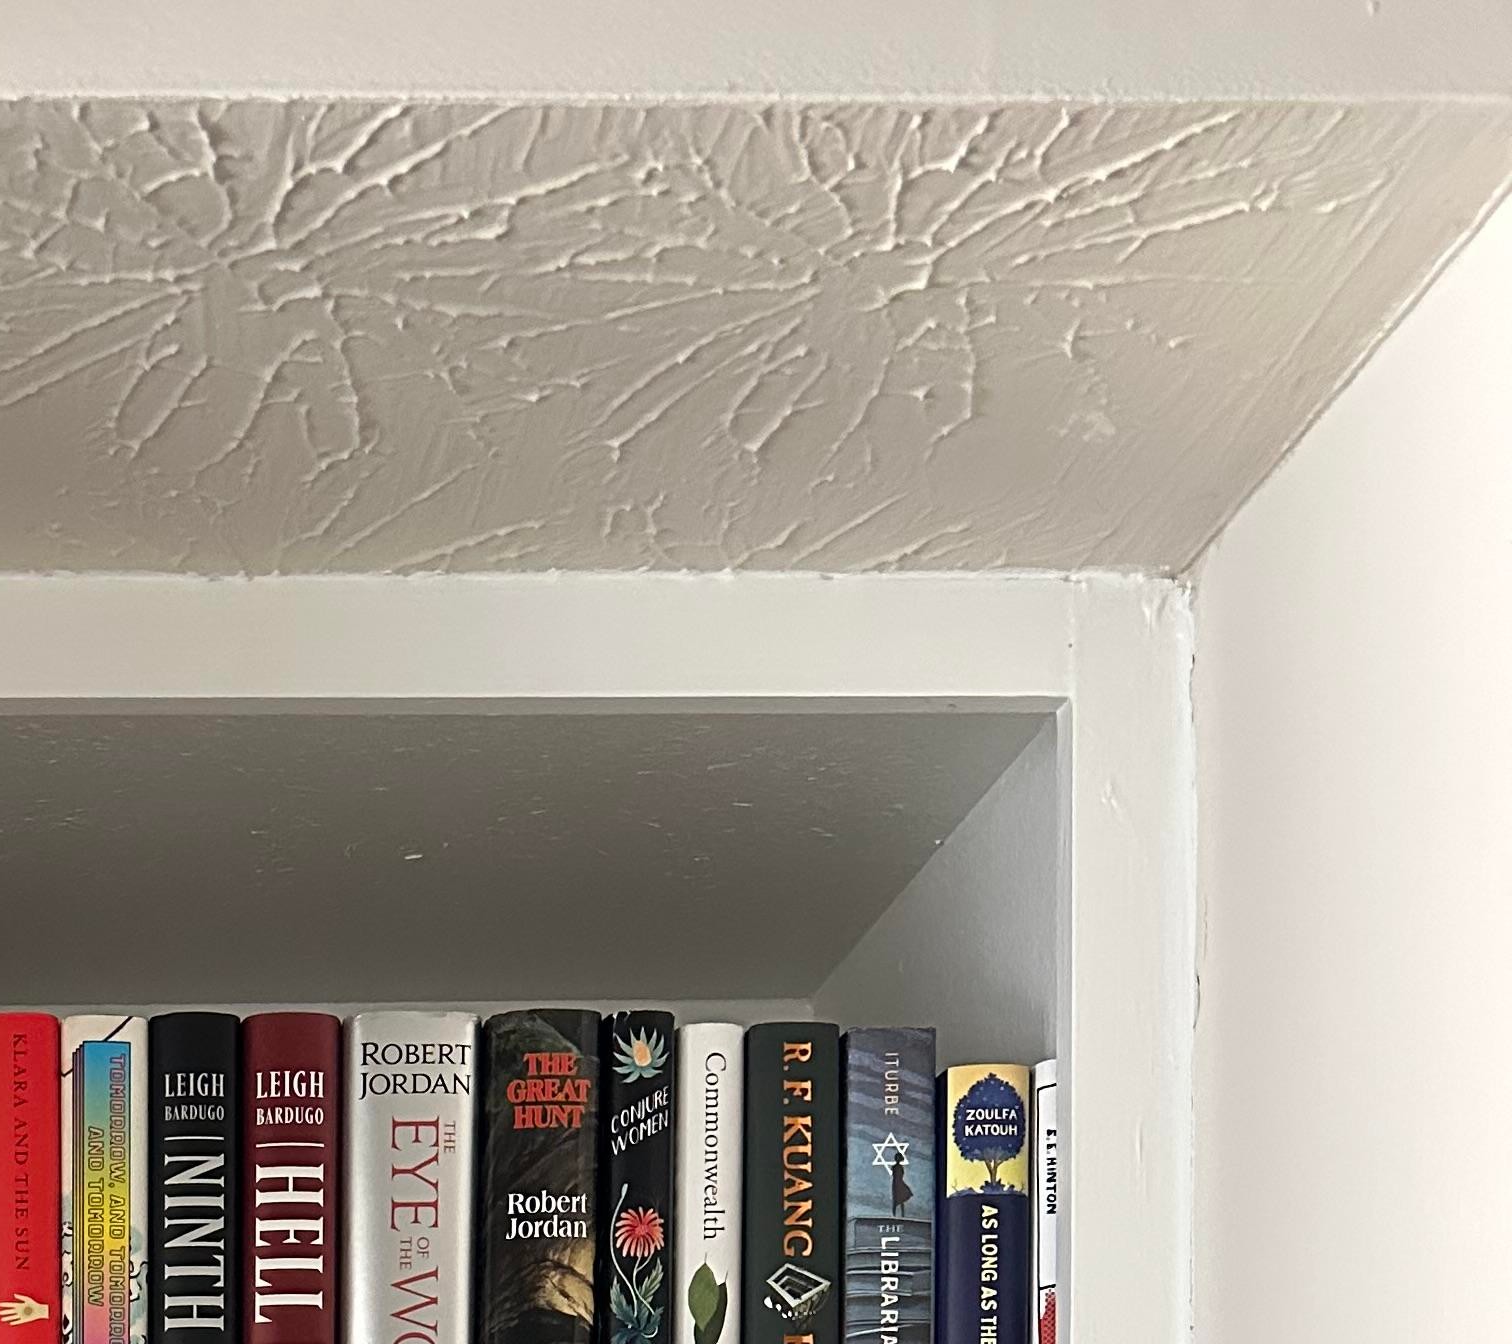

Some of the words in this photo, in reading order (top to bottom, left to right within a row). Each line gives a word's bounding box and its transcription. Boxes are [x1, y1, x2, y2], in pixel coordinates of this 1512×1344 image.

[360, 1041, 472, 1066] ROBERT
[522, 1052, 578, 1078] THE
[783, 1041, 812, 1071] R.
[164, 1073, 225, 1097] LEIGH
[256, 1071, 324, 1098] LEIGH
[359, 1073, 471, 1100] JORDAN
[507, 1078, 591, 1105] GREAT
[783, 1080, 812, 1105] F.
[164, 1103, 225, 1121] BARDUGO
[256, 1105, 324, 1125] BARDUGO
[513, 1105, 584, 1130] HUNT
[966, 1109, 1017, 1122] ZOULFA
[965, 1123, 1018, 1138] KATOUH
[703, 1051, 728, 1240] Commonwealth
[390, 1116, 440, 1232] EYE
[781, 1116, 812, 1258] KUANG
[507, 1191, 587, 1215] Robert
[506, 1215, 588, 1240] Jordan
[164, 1153, 225, 1332] NINTH
[254, 1165, 324, 1324] HELL
